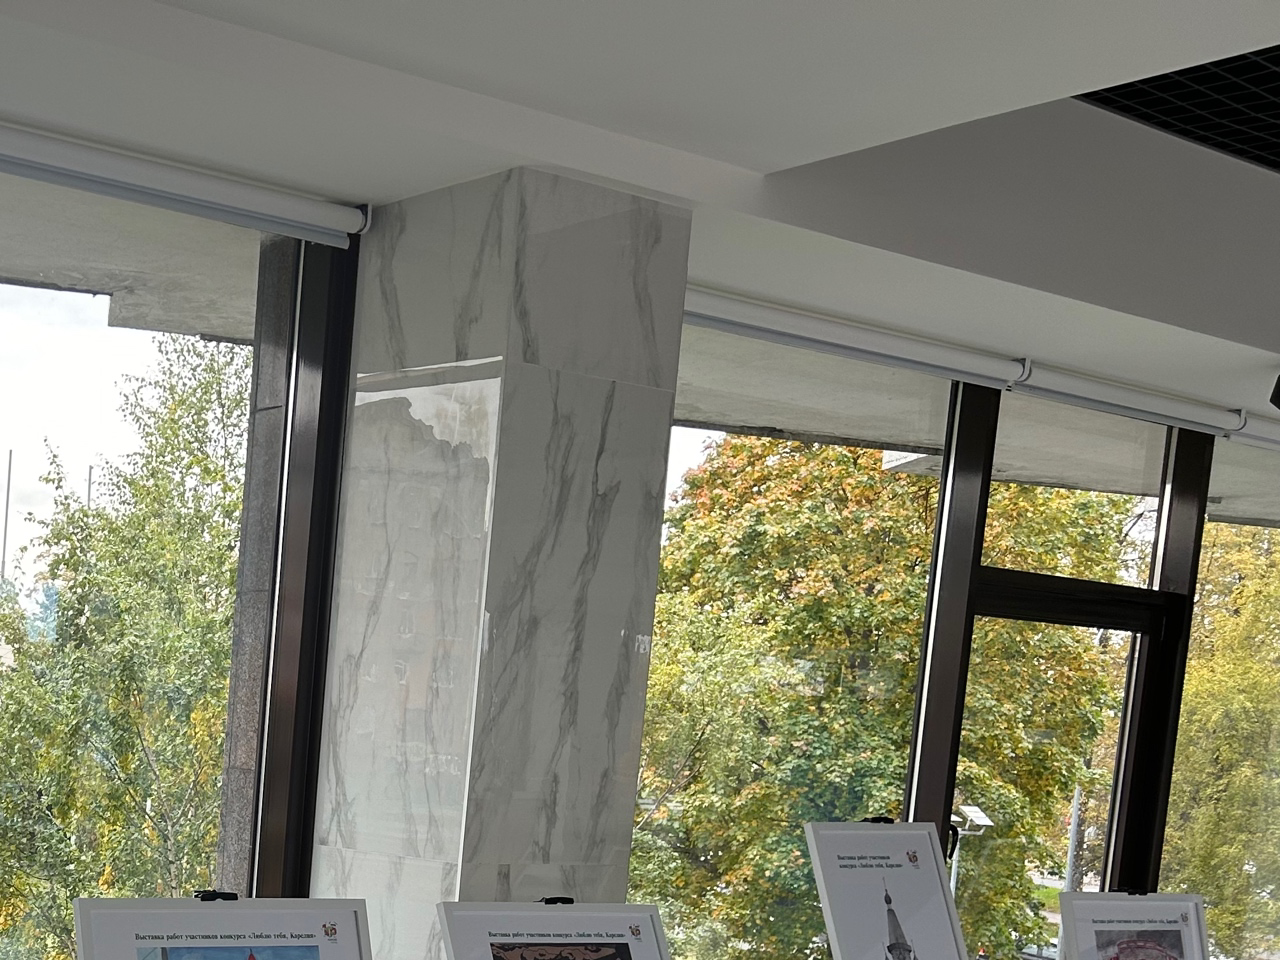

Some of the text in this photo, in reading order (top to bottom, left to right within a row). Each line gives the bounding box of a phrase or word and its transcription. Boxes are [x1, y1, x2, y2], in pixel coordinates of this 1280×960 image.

[134, 932, 165, 941] Выставка
[166, 932, 183, 942] работ
[185, 933, 219, 942] участников
[220, 933, 247, 942] конкурса
